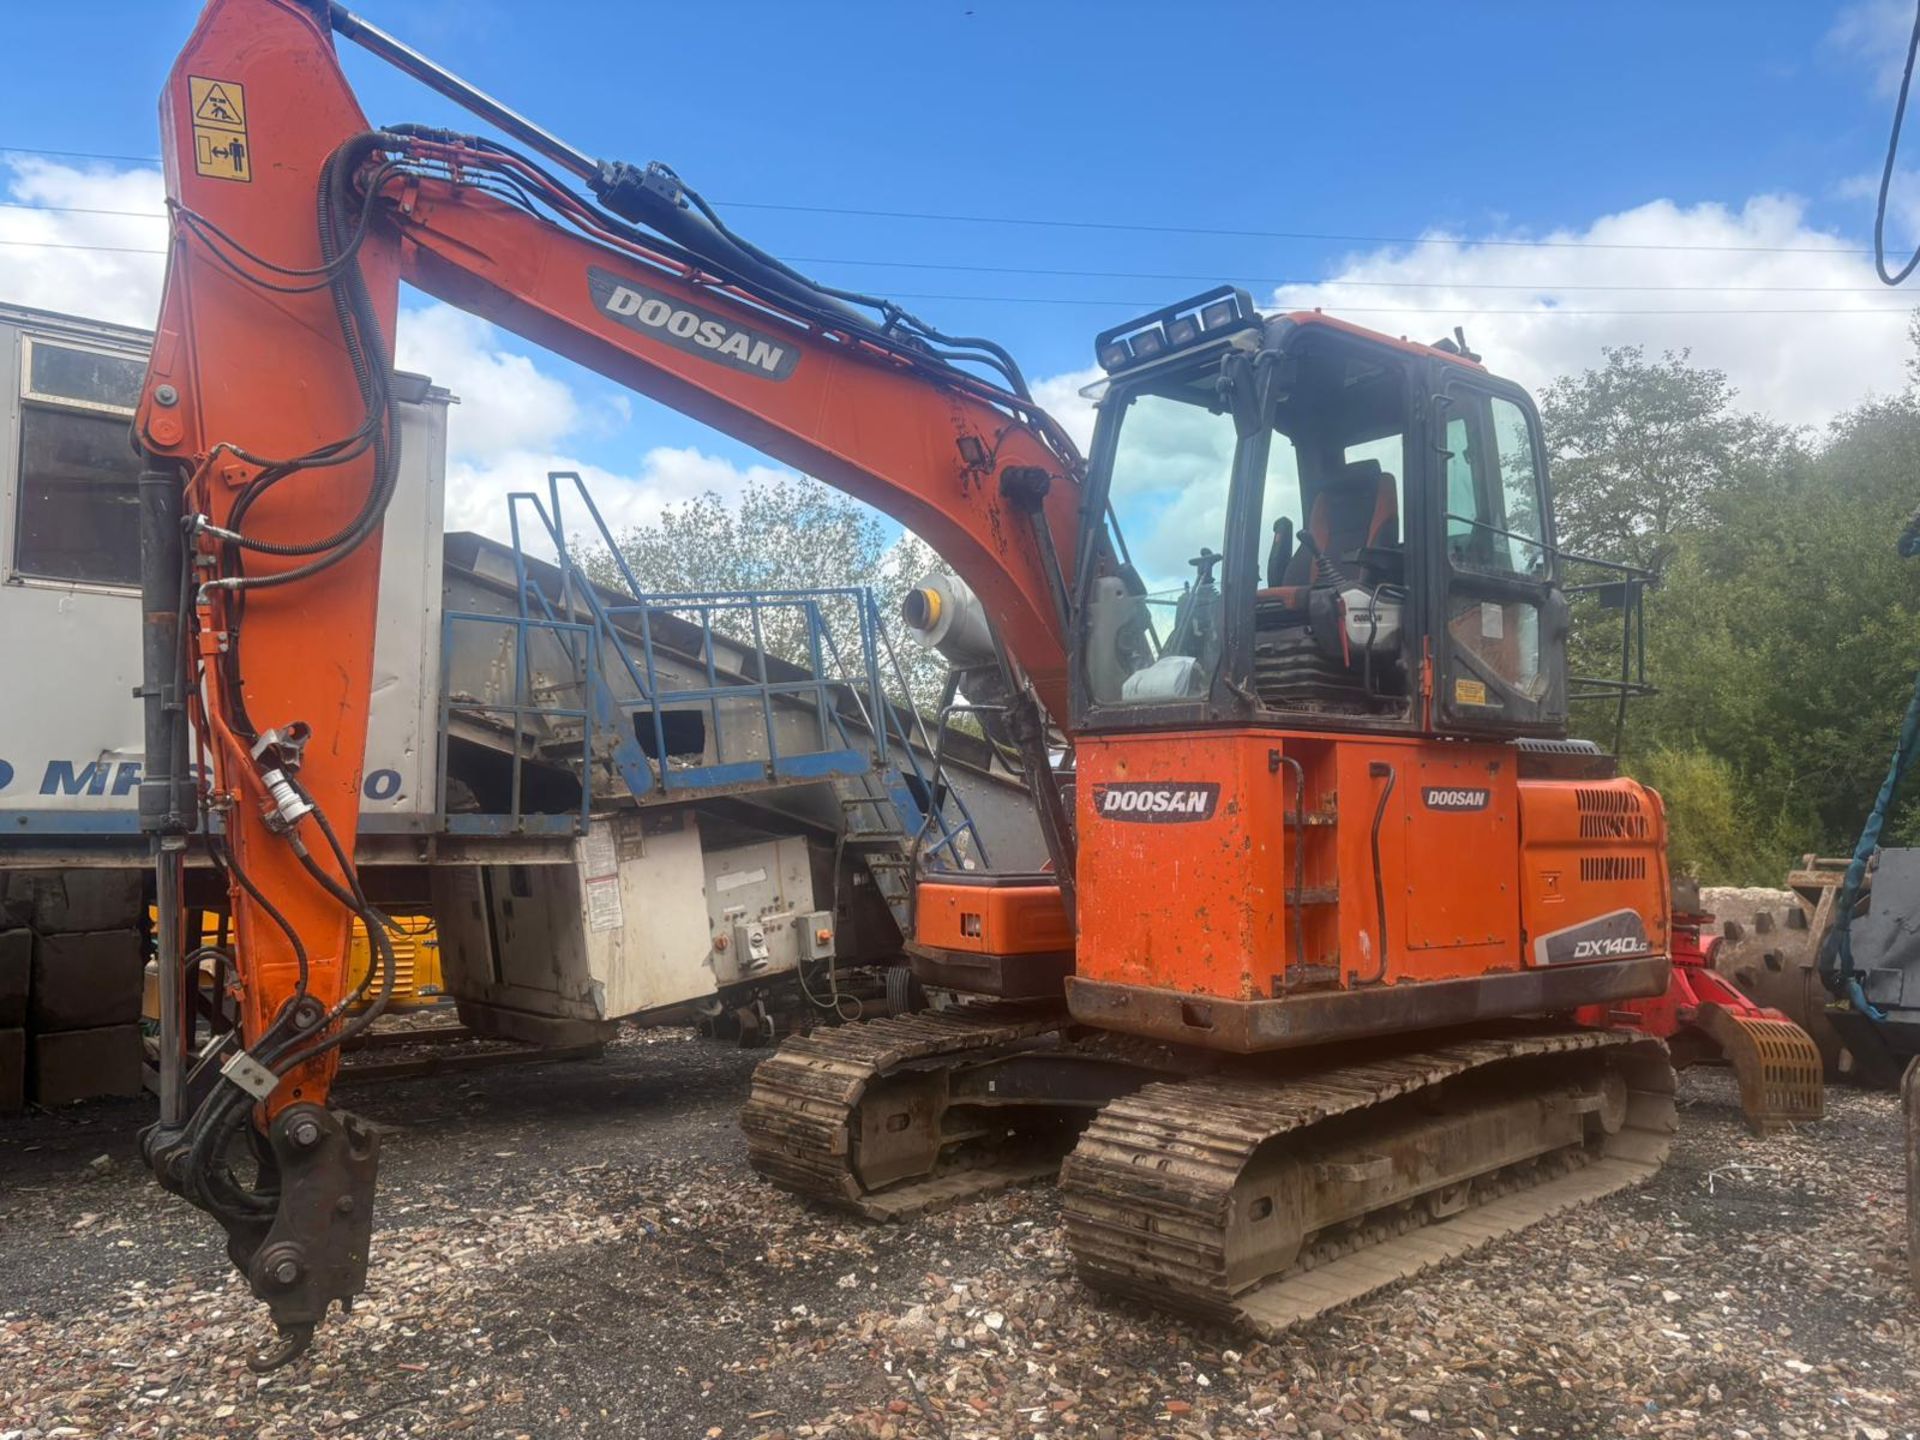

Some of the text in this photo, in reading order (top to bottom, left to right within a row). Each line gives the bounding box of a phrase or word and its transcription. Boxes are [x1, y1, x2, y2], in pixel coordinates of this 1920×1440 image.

[605, 285, 785, 372] DOOSAN
[1103, 790, 1208, 813] DOOSAN
[1427, 790, 1486, 806] DOOSAN
